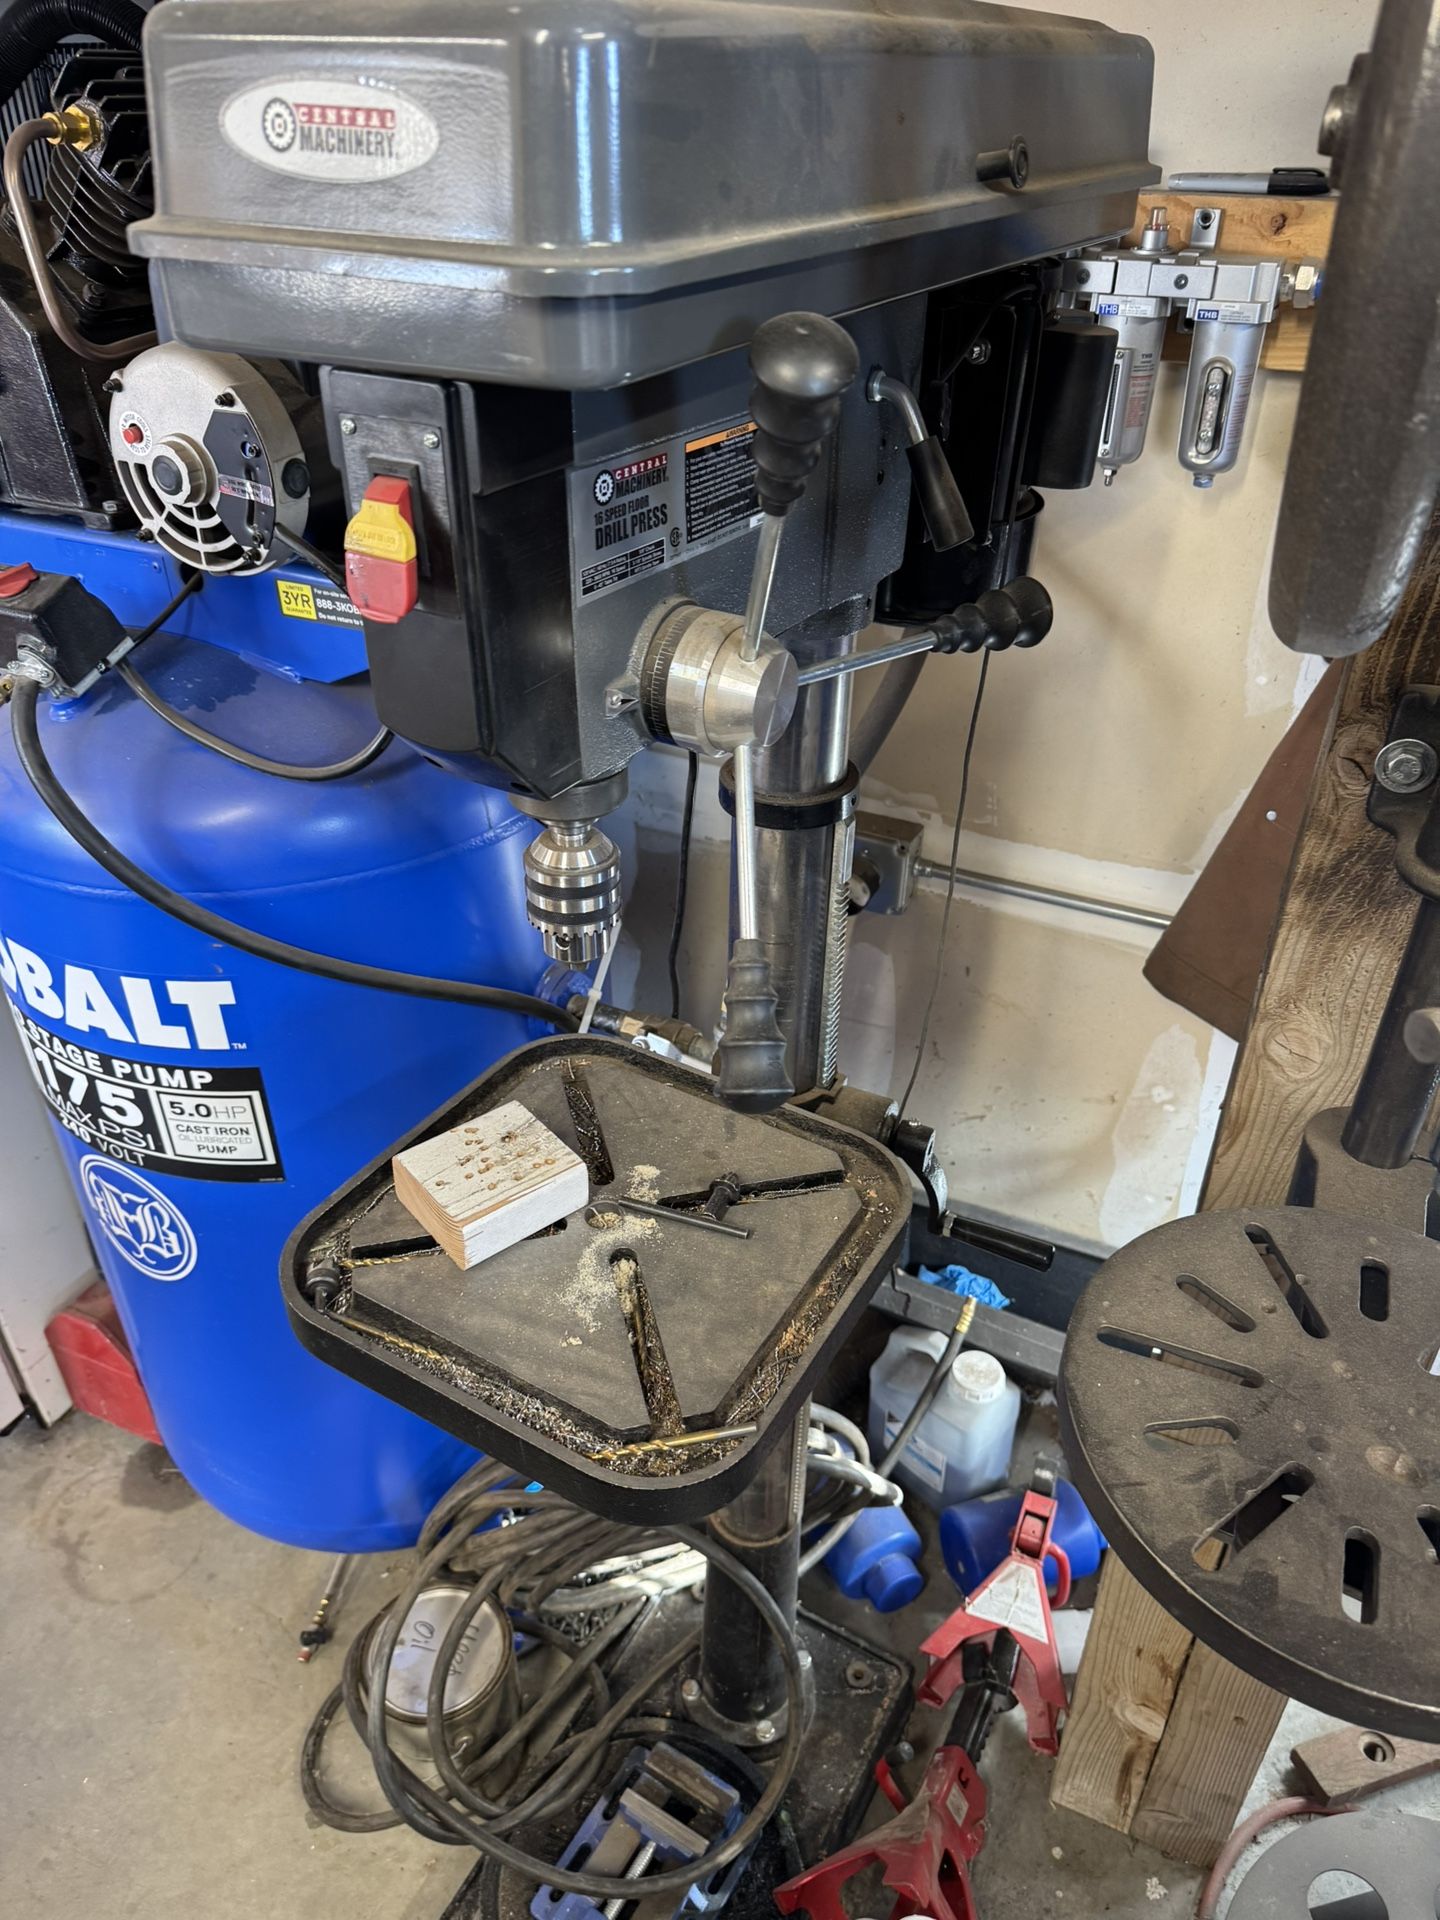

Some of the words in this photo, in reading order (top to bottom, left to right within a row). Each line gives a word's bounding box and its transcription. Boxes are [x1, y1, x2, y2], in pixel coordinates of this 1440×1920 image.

[298, 106, 395, 127] CENTRAL
[1100, 304, 1118, 315] THB
[1200, 311, 1218, 320] THB
[615, 456, 667, 480] CENTRAL
[594, 511, 604, 526] 16
[604, 503, 627, 522] SPEED
[595, 518, 629, 551] DRILL
[631, 503, 668, 537] PRESS
[282, 590, 312, 608] 3YR
[26, 1018, 103, 1073] STAGE
[111, 1058, 214, 1090] PUMP
[34, 1046, 145, 1127] 175
[47, 1083, 97, 1130] MAX
[98, 1117, 156, 1151] PSI
[176, 1123, 211, 1136] CAST
[214, 1126, 251, 1136] IRON
[194, 1134, 254, 1145] LUBRICATED
[96, 1136, 146, 1166] VOLT
[197, 1144, 238, 1154] PUMP
